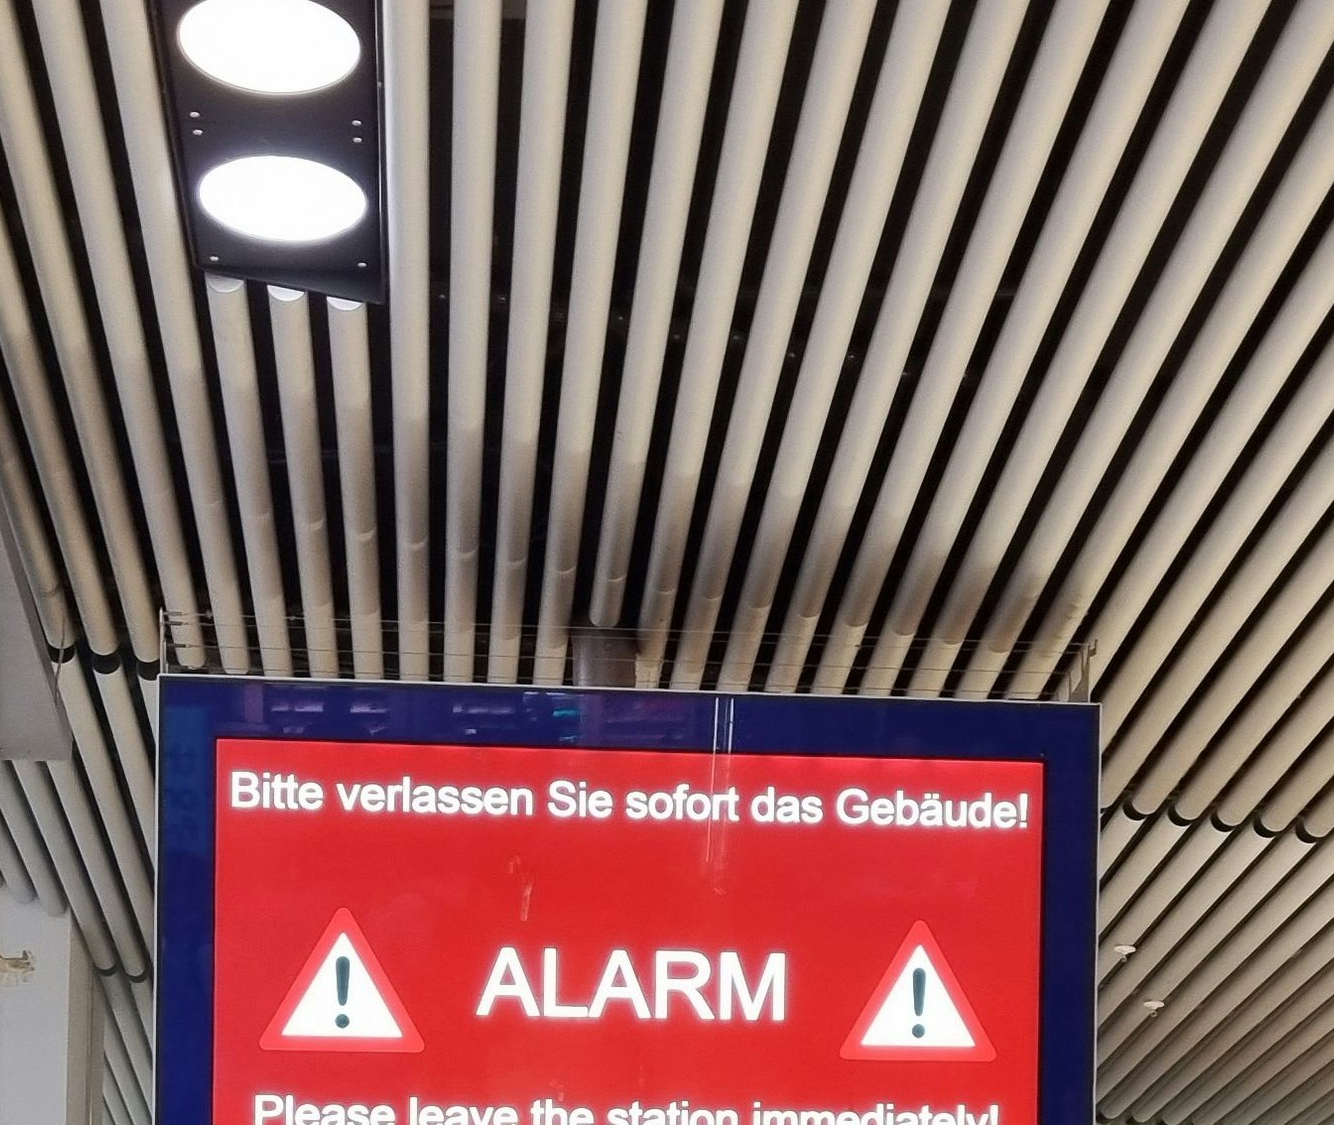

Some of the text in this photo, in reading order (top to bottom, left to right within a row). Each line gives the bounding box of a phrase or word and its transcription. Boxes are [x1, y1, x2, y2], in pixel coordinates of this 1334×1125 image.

[229, 770, 1029, 829] Bitte verlassen Sie sofort das Gebäude!
[475, 946, 786, 1022] ALARM
